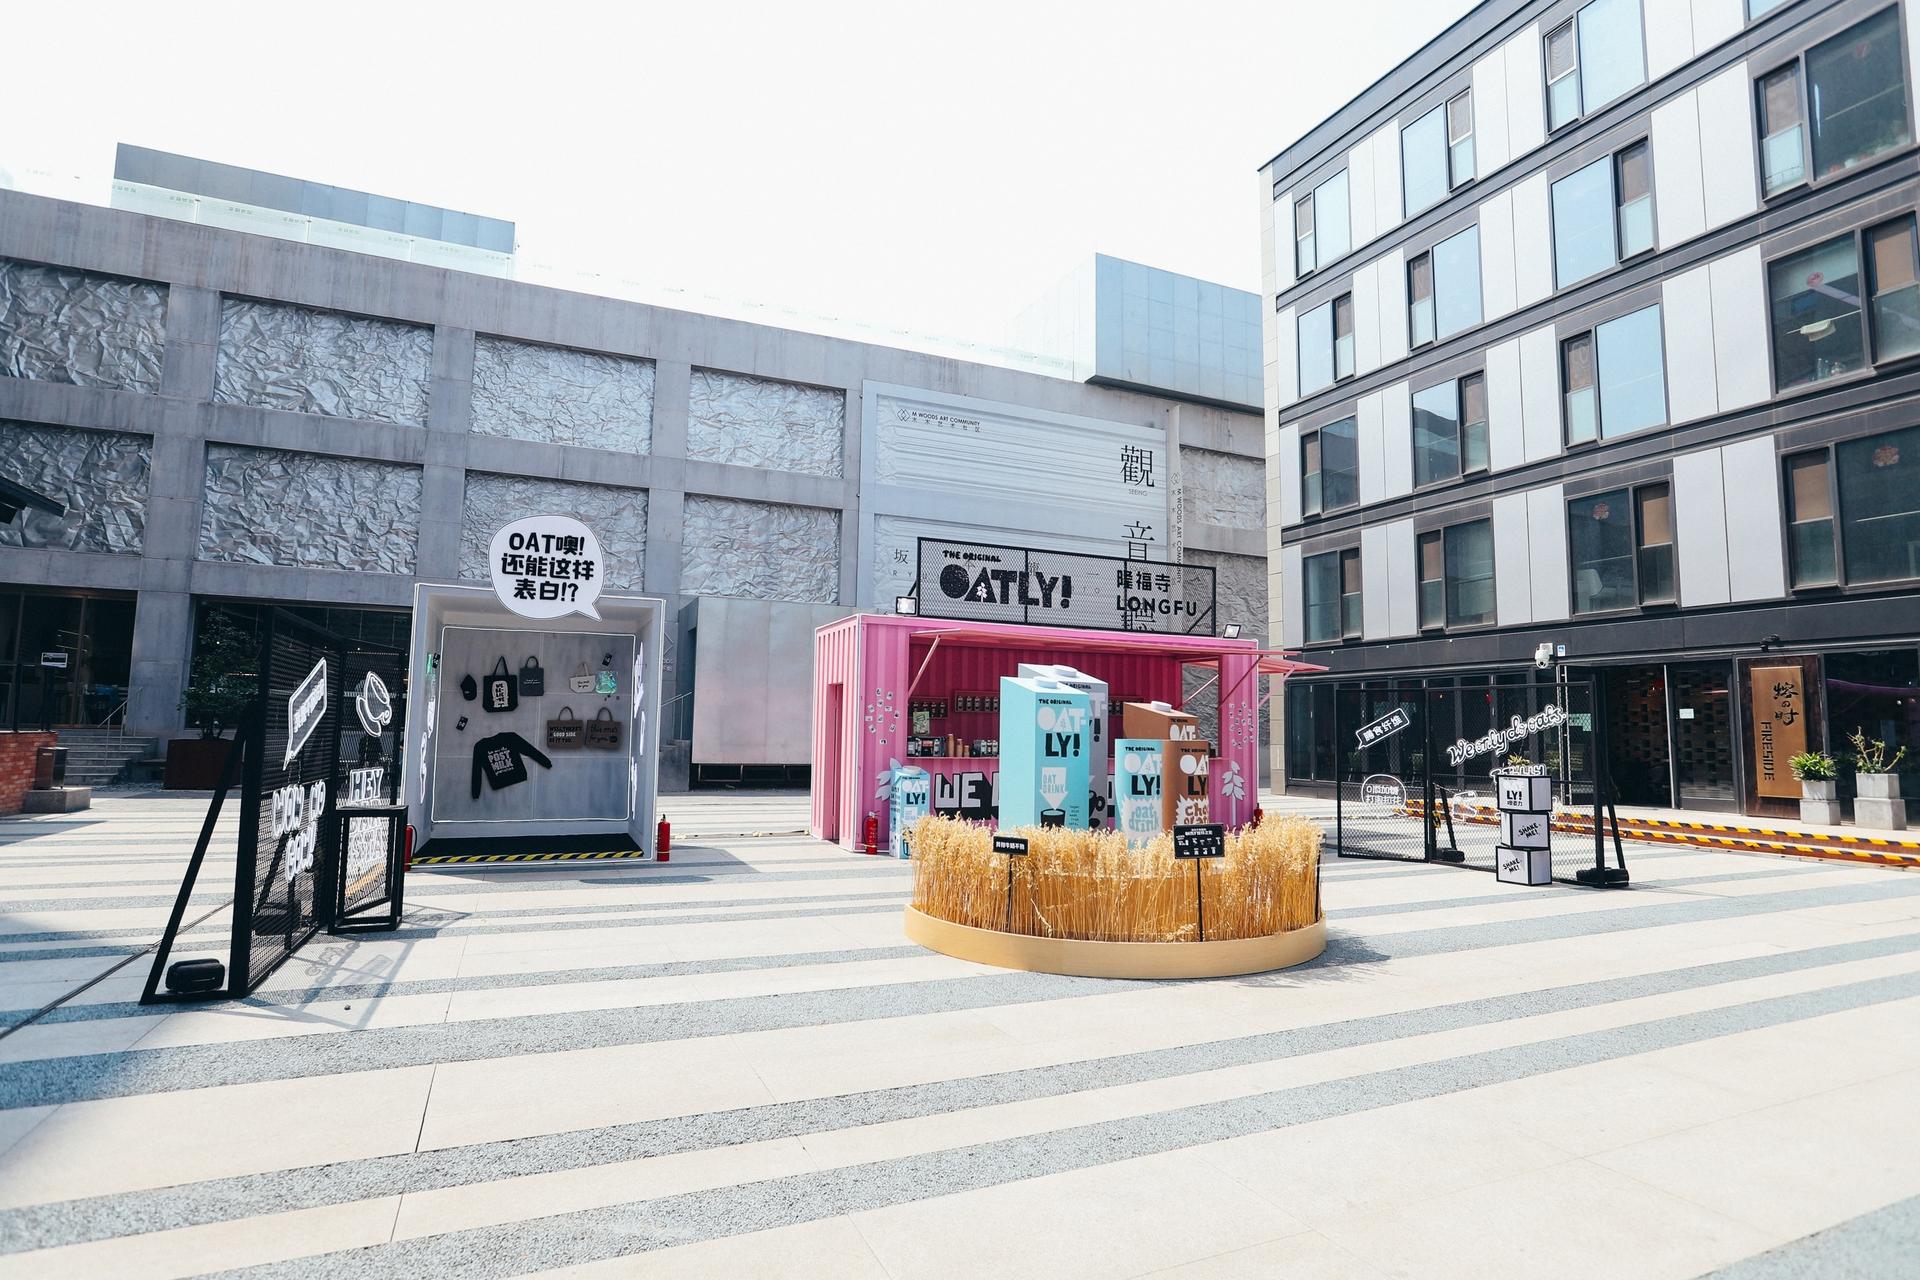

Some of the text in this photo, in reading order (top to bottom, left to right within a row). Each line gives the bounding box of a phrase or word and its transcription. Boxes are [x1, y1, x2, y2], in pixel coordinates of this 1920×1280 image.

[918, 412, 938, 421] WOODS
[949, 417, 980, 427] COMMUNITY
[1120, 444, 1155, 488] 觀
[509, 532, 585, 556] OAT噢!
[1121, 520, 1155, 561] 音
[501, 553, 595, 580] 还能这样
[894, 548, 909, 565] 坂
[942, 549, 1002, 563] THE ORIGINAL
[513, 578, 579, 602] 表白!?
[939, 563, 1072, 610] OATLY!
[1116, 569, 1171, 593] 隆福寺
[1116, 594, 1197, 617] LONGFU
[1045, 732, 1080, 758] LY!
[1446, 738, 1475, 767] We
[1475, 728, 1509, 758] only
[1507, 714, 1528, 741] do
[1760, 721, 1775, 781] FIRESIDE
[488, 749, 511, 763] POST
[349, 766, 384, 803] HEY
[933, 771, 983, 810] WE
[1042, 784, 1065, 794] DRINK
[1131, 774, 1161, 796] LY!
[1506, 790, 1523, 801] LY!
[906, 792, 926, 805] LY!
[1518, 822, 1539, 836] SHAKE
[1525, 829, 1539, 839] ME!
[1502, 857, 1521, 871] SHAKE
[1508, 864, 1520, 873] ME!
